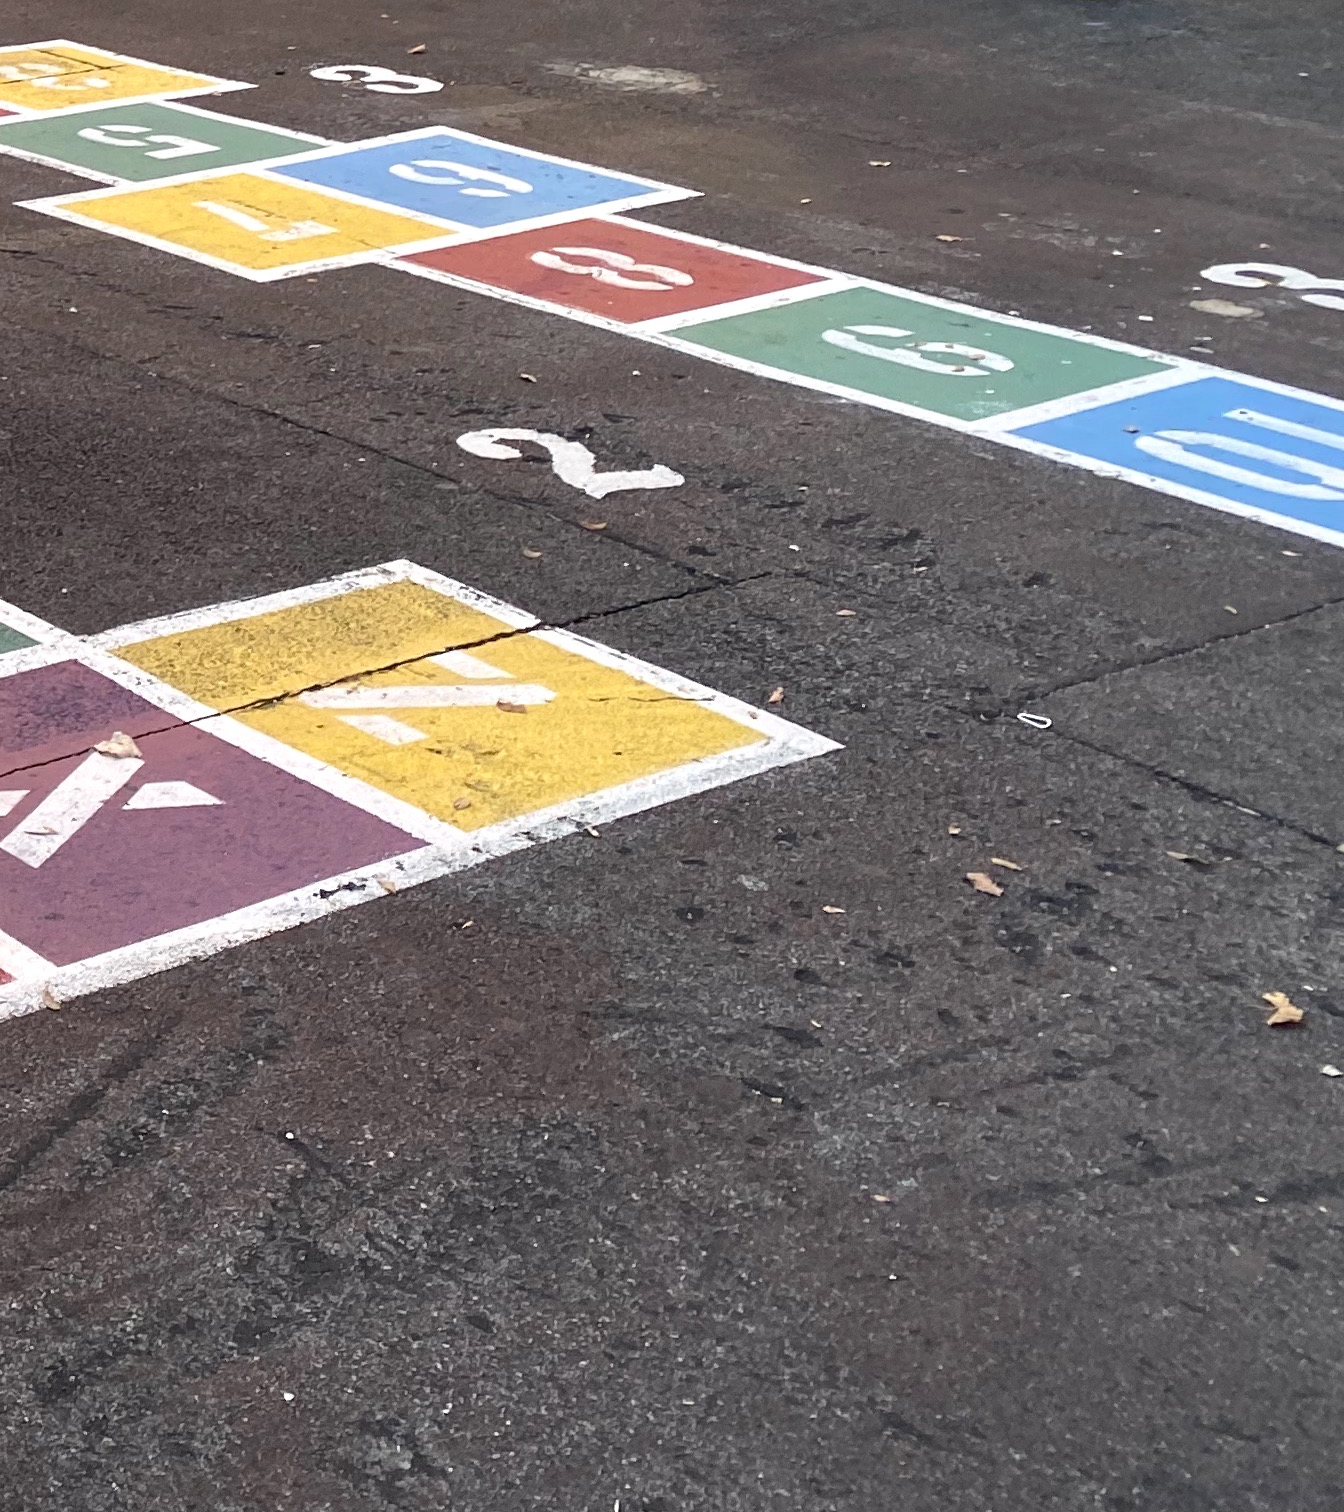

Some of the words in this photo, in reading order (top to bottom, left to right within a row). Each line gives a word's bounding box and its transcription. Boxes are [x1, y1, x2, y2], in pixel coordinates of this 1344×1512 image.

[310, 64, 444, 95] 3
[76, 124, 222, 160] 5
[388, 159, 534, 199] 6
[191, 200, 340, 242] 7
[528, 246, 696, 291] 8
[820, 324, 1016, 377] 9
[455, 426, 686, 500] 2
[297, 649, 558, 747] Z
